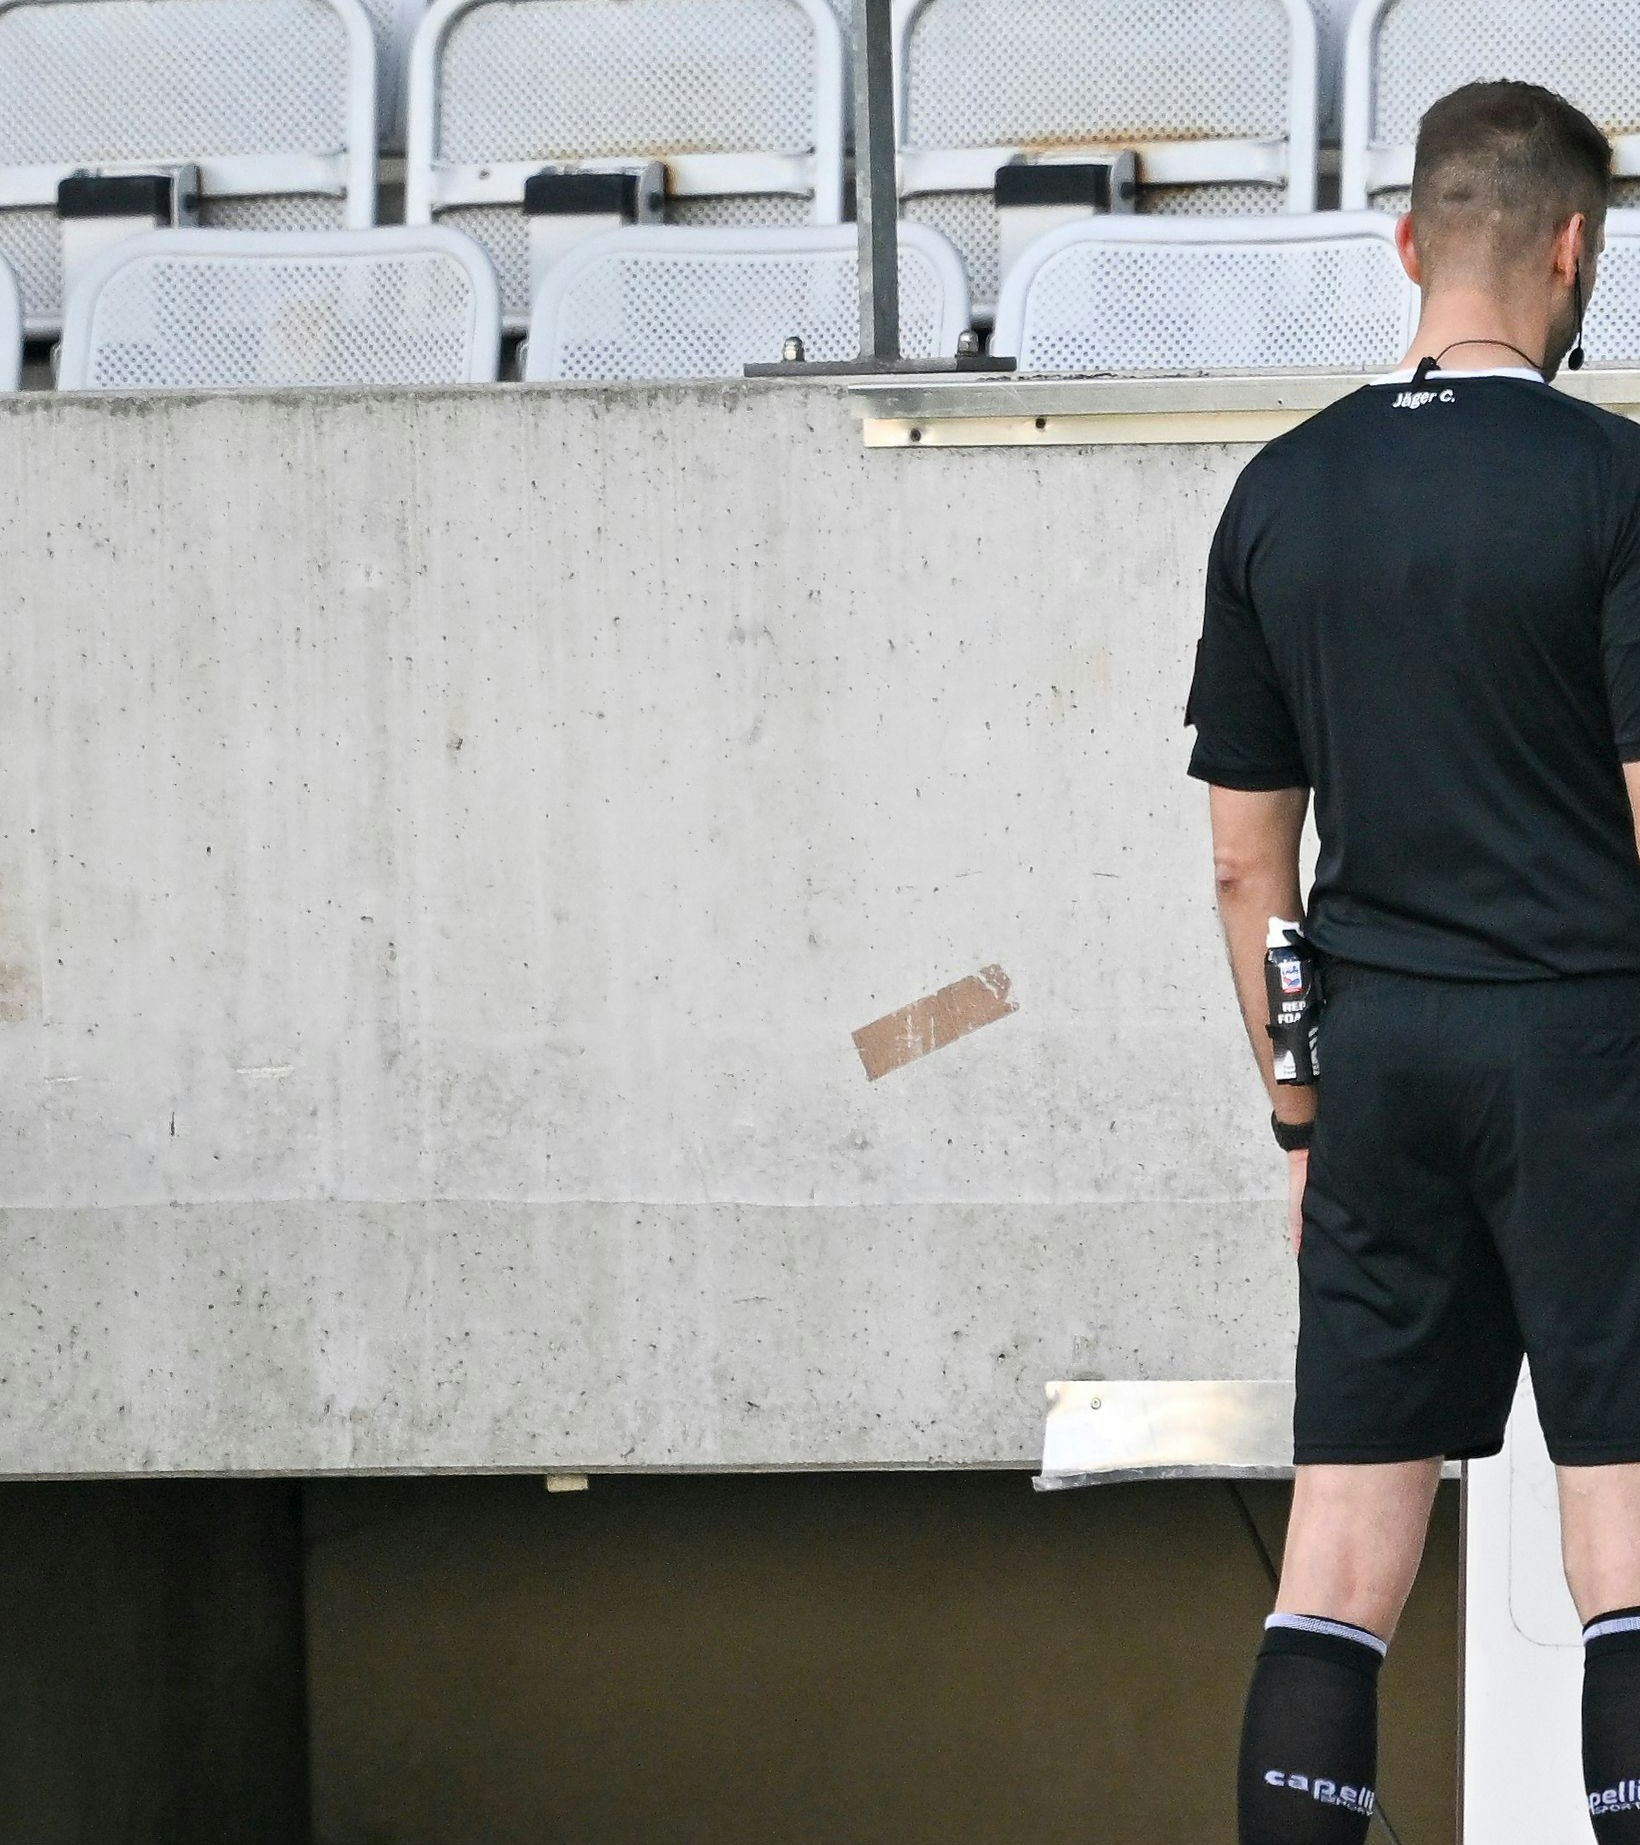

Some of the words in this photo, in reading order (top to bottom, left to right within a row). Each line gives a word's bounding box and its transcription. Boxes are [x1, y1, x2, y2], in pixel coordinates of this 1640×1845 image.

[1392, 391, 1437, 409] Jäger
[1440, 389, 1455, 403] C.
[1264, 1770, 1375, 1811] capelli
